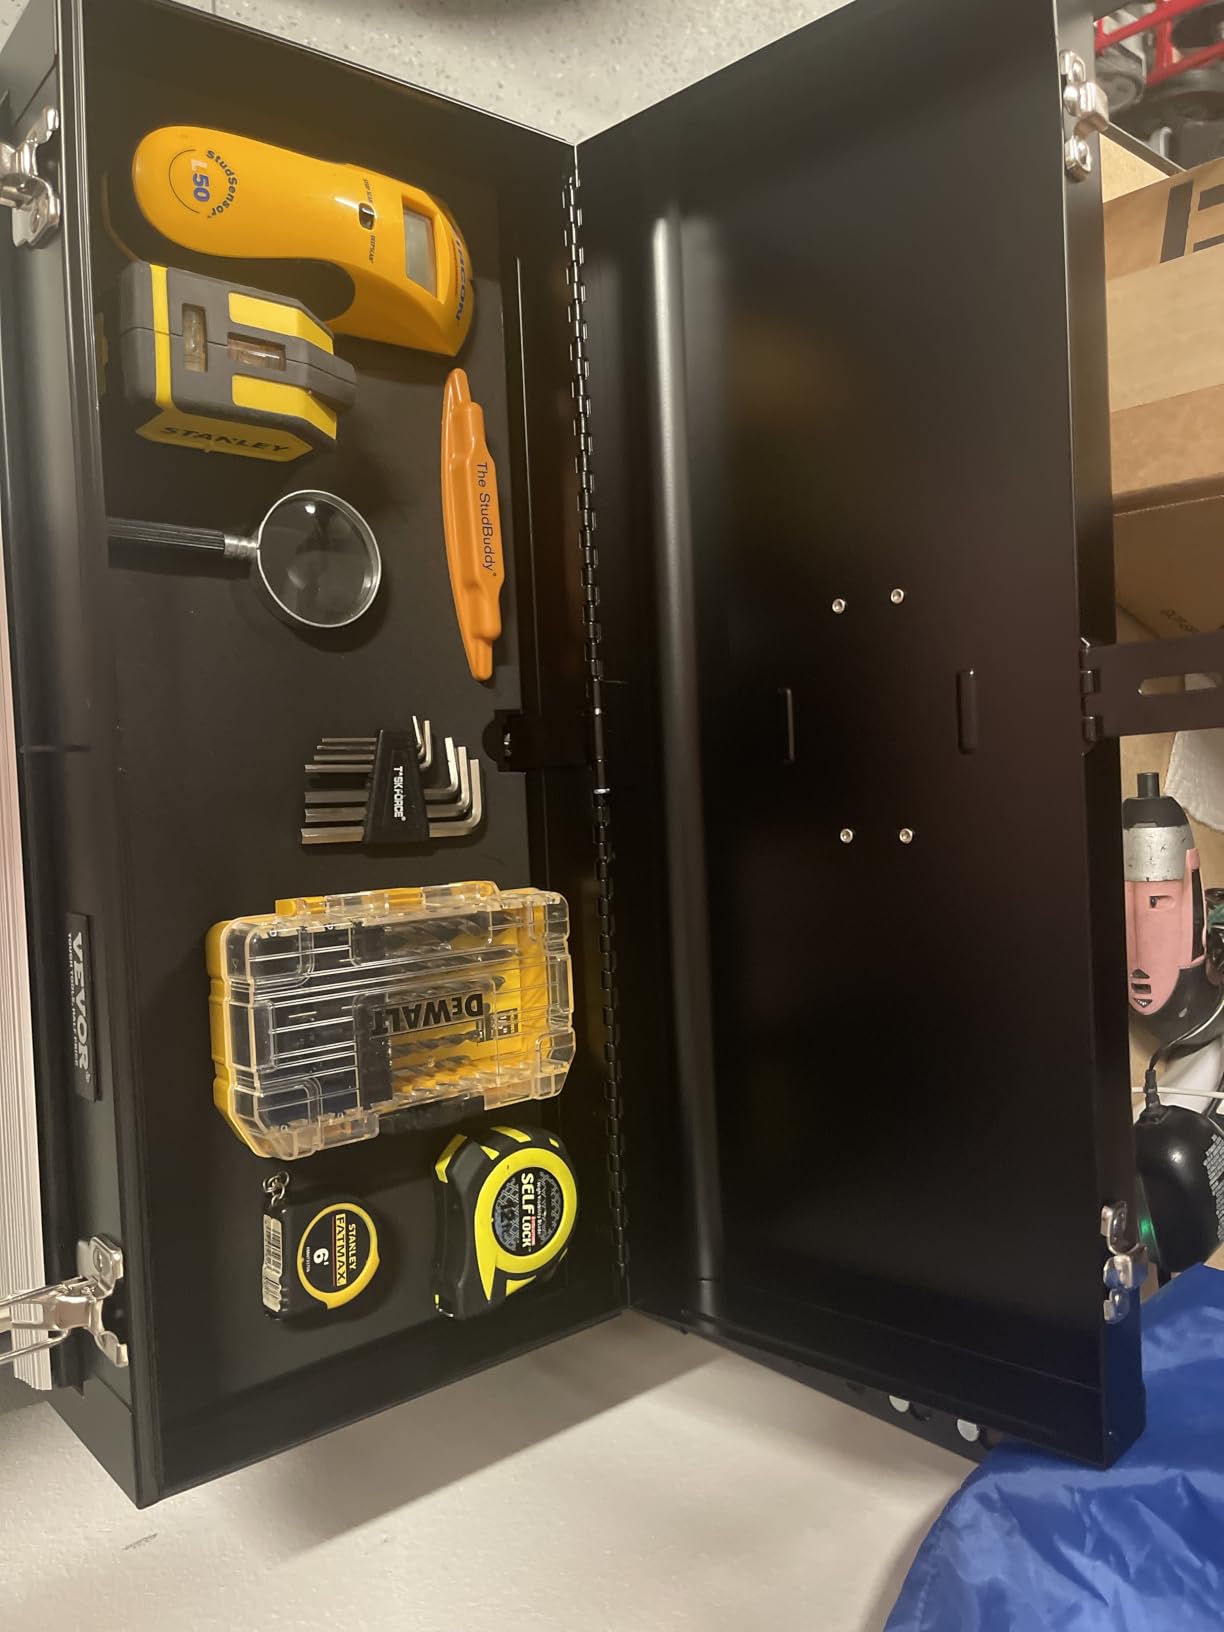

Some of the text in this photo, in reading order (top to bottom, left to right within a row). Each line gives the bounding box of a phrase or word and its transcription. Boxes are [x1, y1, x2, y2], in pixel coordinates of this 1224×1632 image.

[206, 150, 238, 217] StudSensor
[160, 426, 290, 452] STANLEY
[477, 462, 496, 572] The StudBuddy
[72, 932, 89, 1069] VEVOR
[521, 1172, 535, 1215] SELF
[336, 1216, 346, 1283] FATMAX
[348, 1223, 357, 1270] STANLEY
[522, 1216, 532, 1248] LOCK
